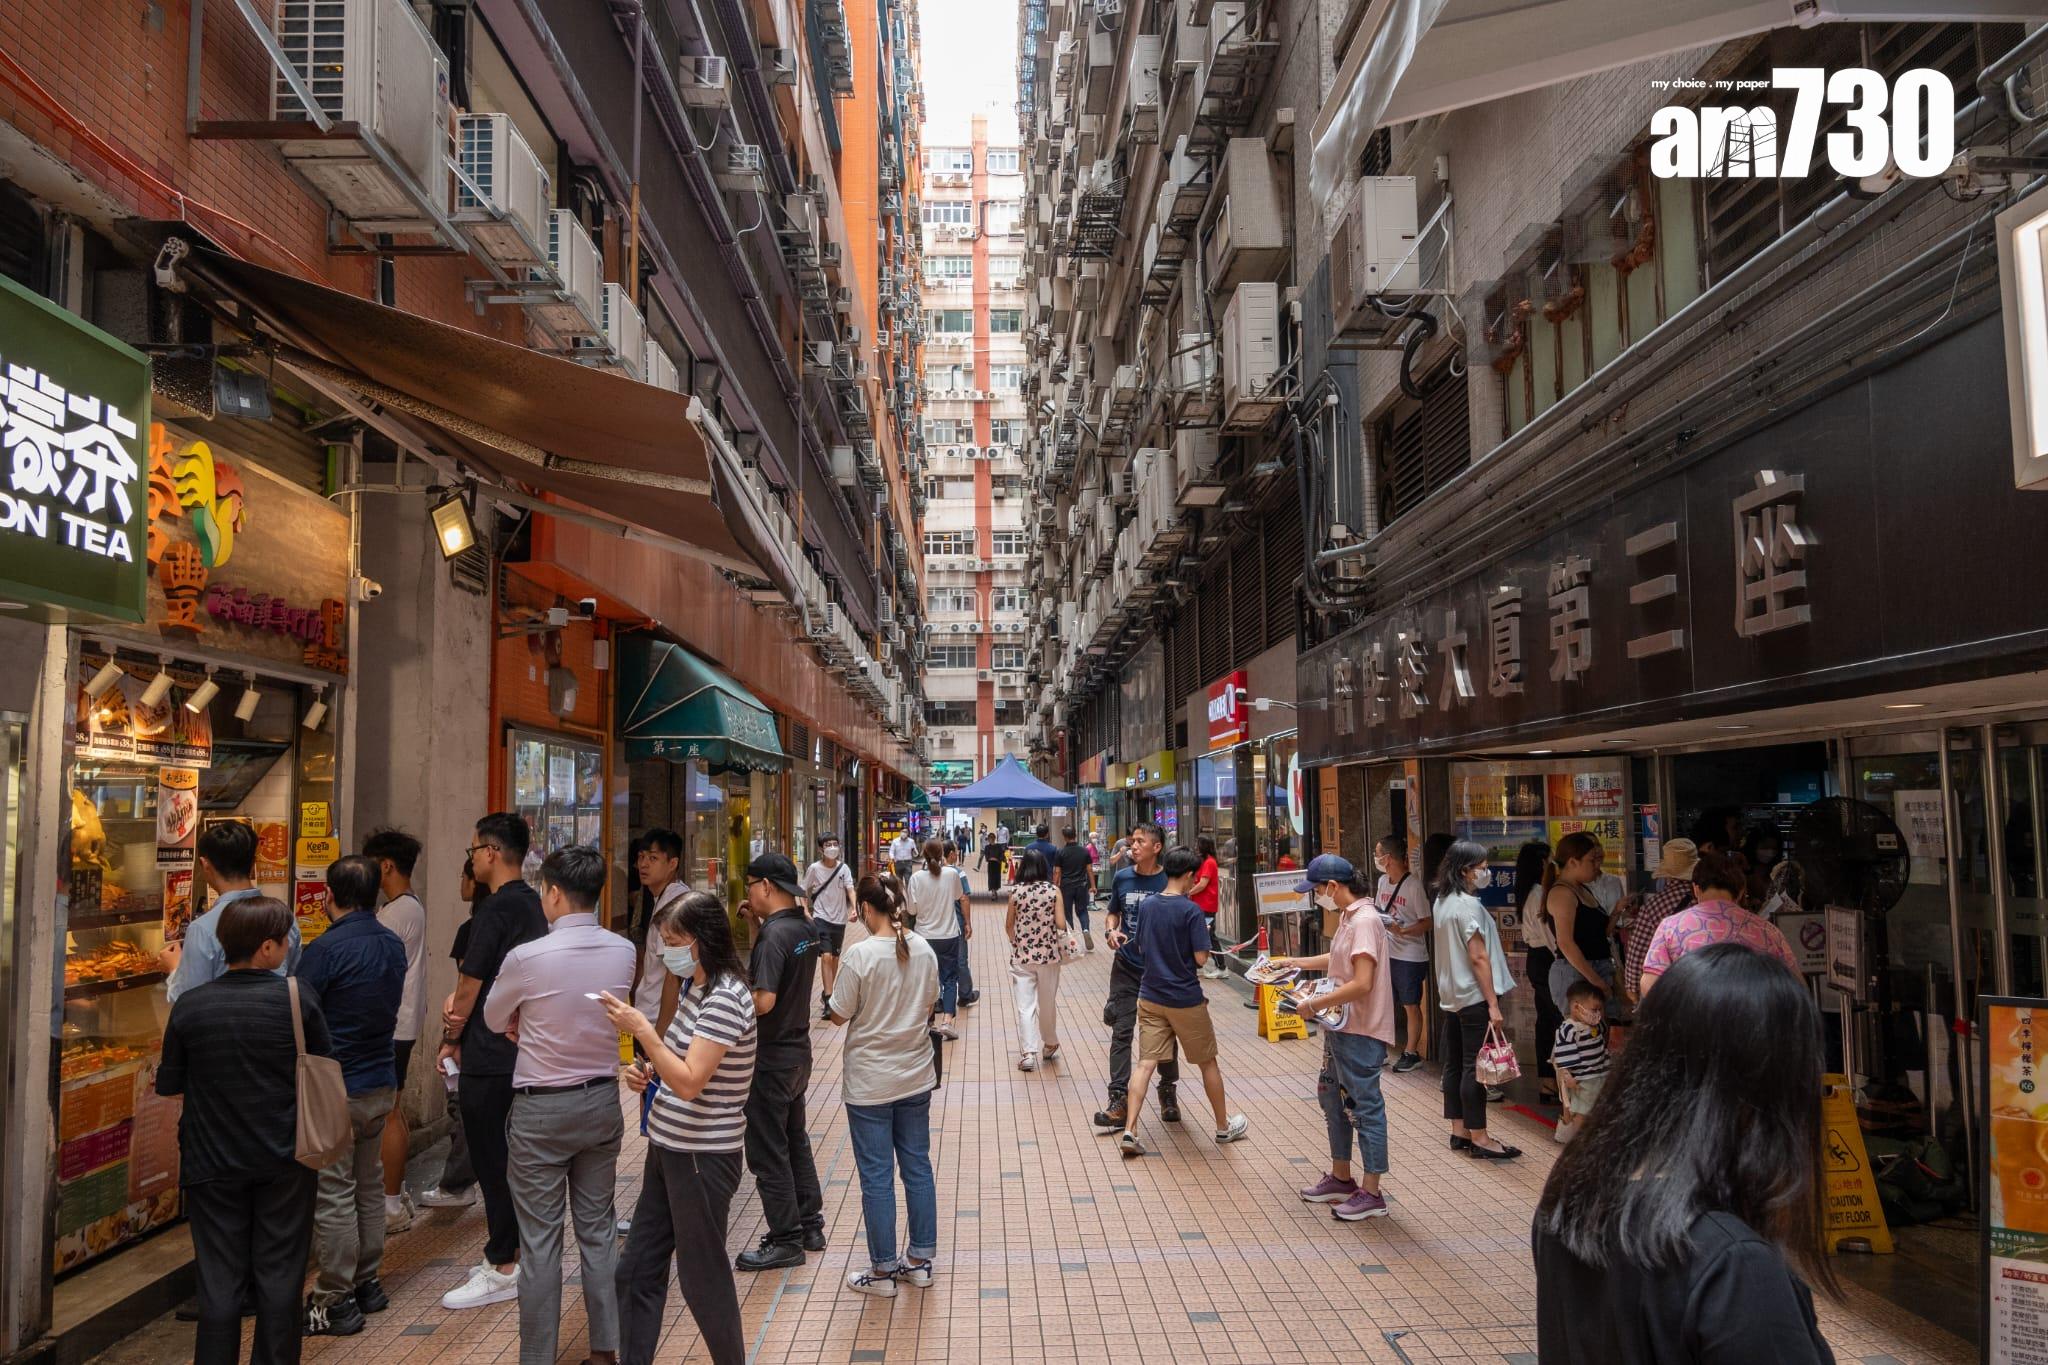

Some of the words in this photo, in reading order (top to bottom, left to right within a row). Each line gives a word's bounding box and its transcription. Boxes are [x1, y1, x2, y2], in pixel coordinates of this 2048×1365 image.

[60, 511, 133, 563] TEA
[651, 739, 701, 757] 第一座
[307, 841, 330, 853] KeeTa
[1830, 1194, 1863, 1207] CAUTION
[1845, 1210, 1872, 1223] FLOOR
